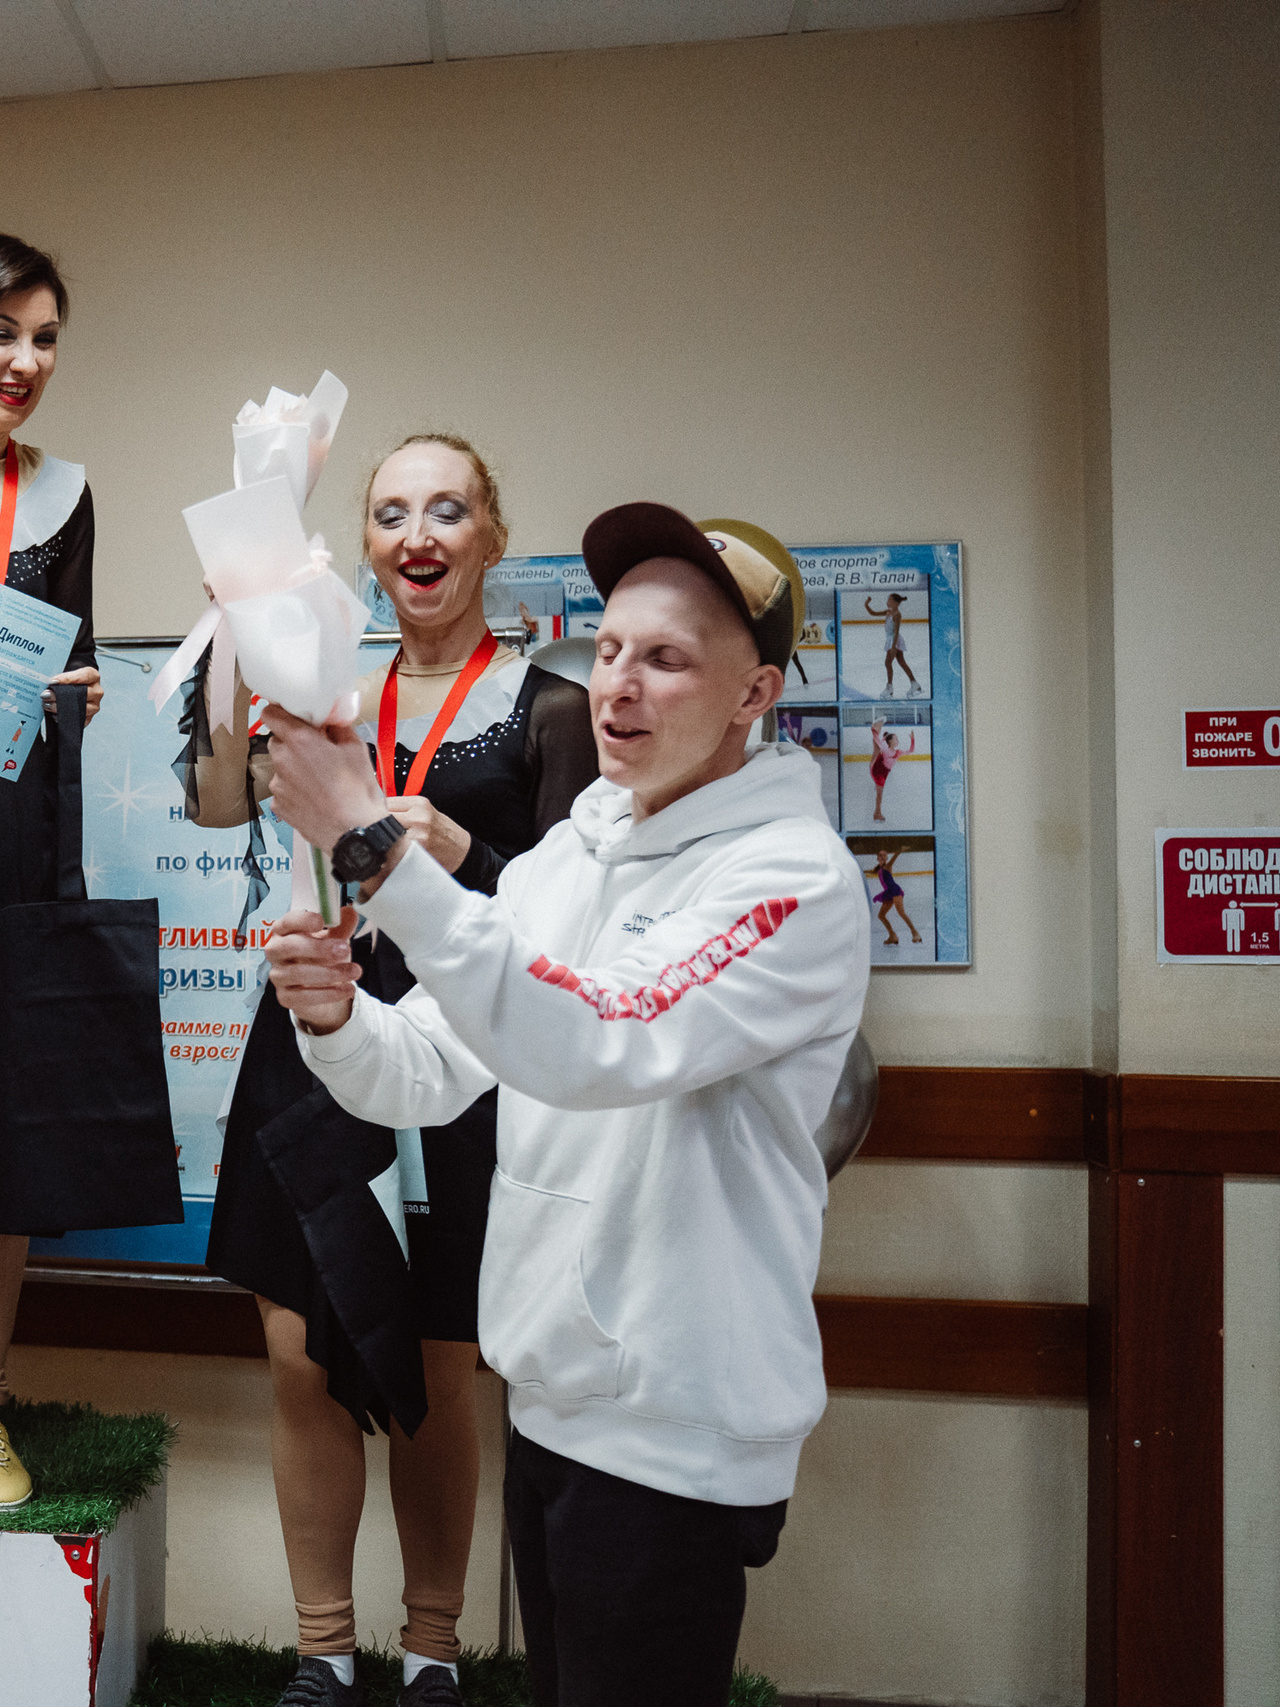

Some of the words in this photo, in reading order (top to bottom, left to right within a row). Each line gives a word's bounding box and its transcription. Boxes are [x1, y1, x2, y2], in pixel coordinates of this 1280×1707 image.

[871, 571, 916, 584] Талан
[1209, 717, 1237, 727] ПРИ
[1194, 732, 1253, 743] ПОЖАРЕ
[1192, 748, 1256, 759] ЗВОНИТЬ
[156, 856, 188, 871] по
[1250, 932, 1270, 944] 1,5
[159, 968, 243, 995] ризы
